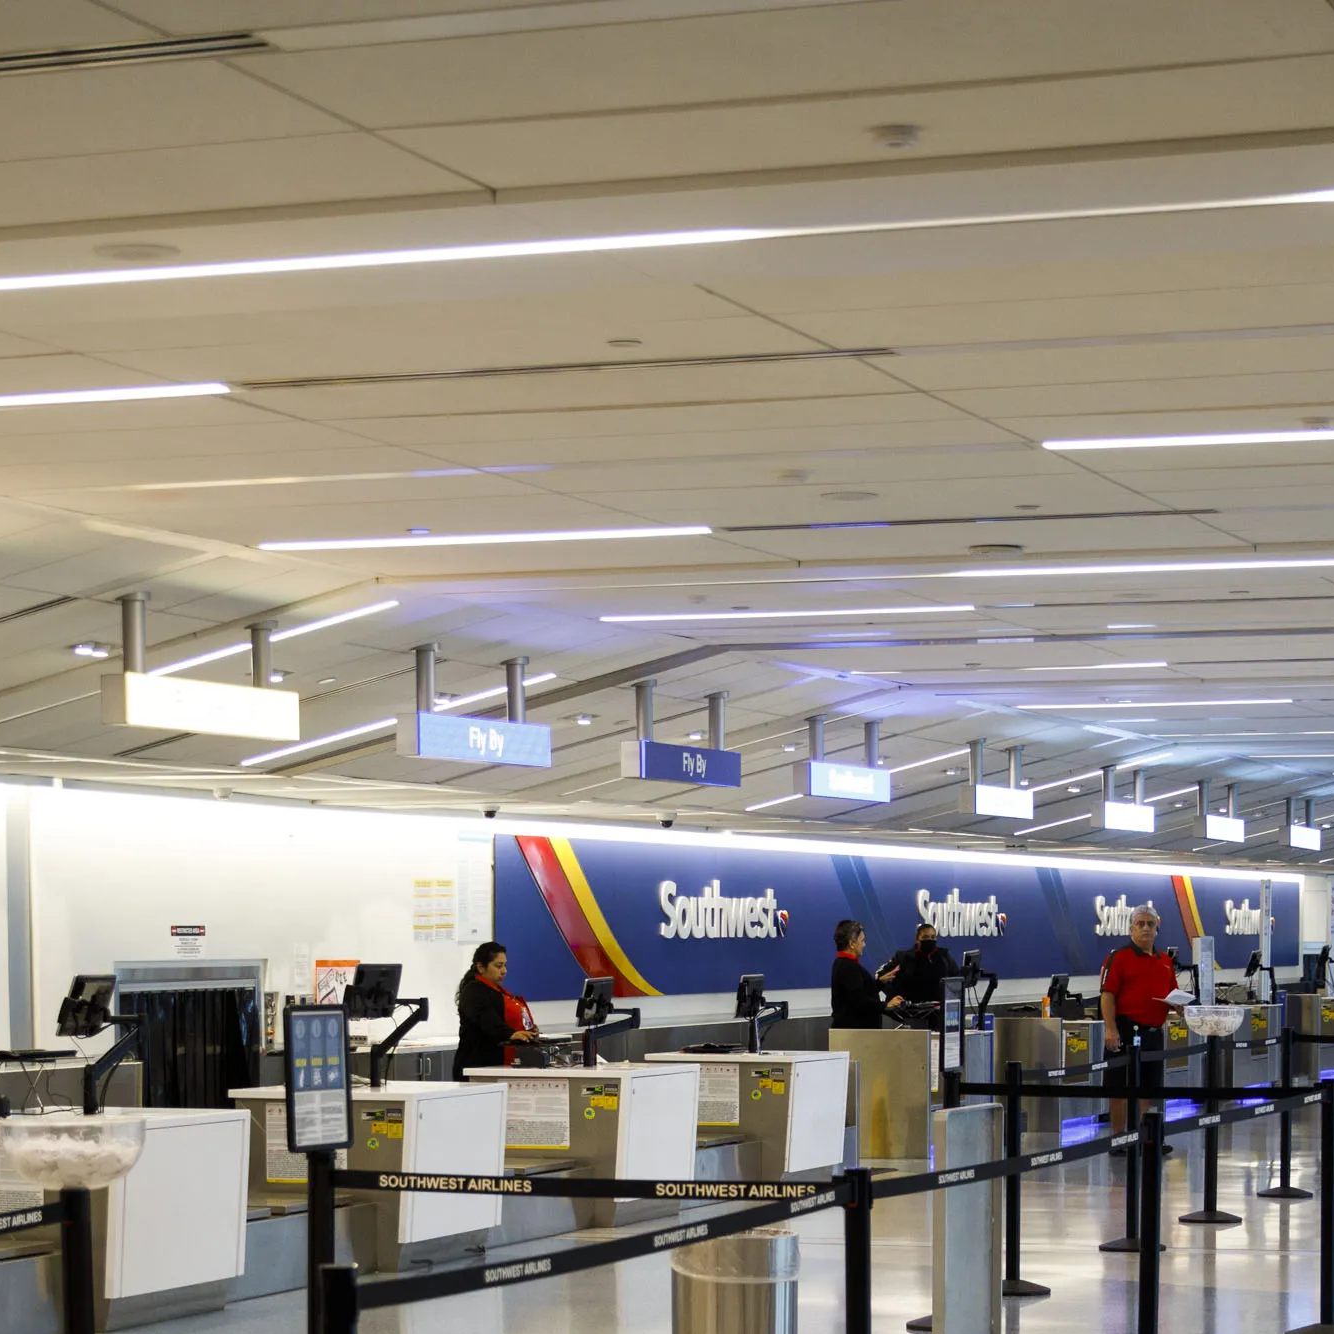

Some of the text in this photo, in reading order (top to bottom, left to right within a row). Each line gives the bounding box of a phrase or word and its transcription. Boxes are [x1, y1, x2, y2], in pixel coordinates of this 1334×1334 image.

[468, 725, 505, 757] Fly By
[682, 751, 707, 778] Fly By
[659, 879, 777, 939] Southwest
[917, 887, 998, 937] Southwest
[1225, 898, 1262, 935] Southw
[379, 1174, 532, 1193] SOUTHWEST AIRLINES
[655, 1183, 816, 1198] SOUTHWEST AIRLINES
[12, 1210, 42, 1227] AIRLINES
[654, 1223, 709, 1248] SOUTHWEST AIRLINES
[485, 1258, 551, 1283] SOUTHWEST AIRLINES
